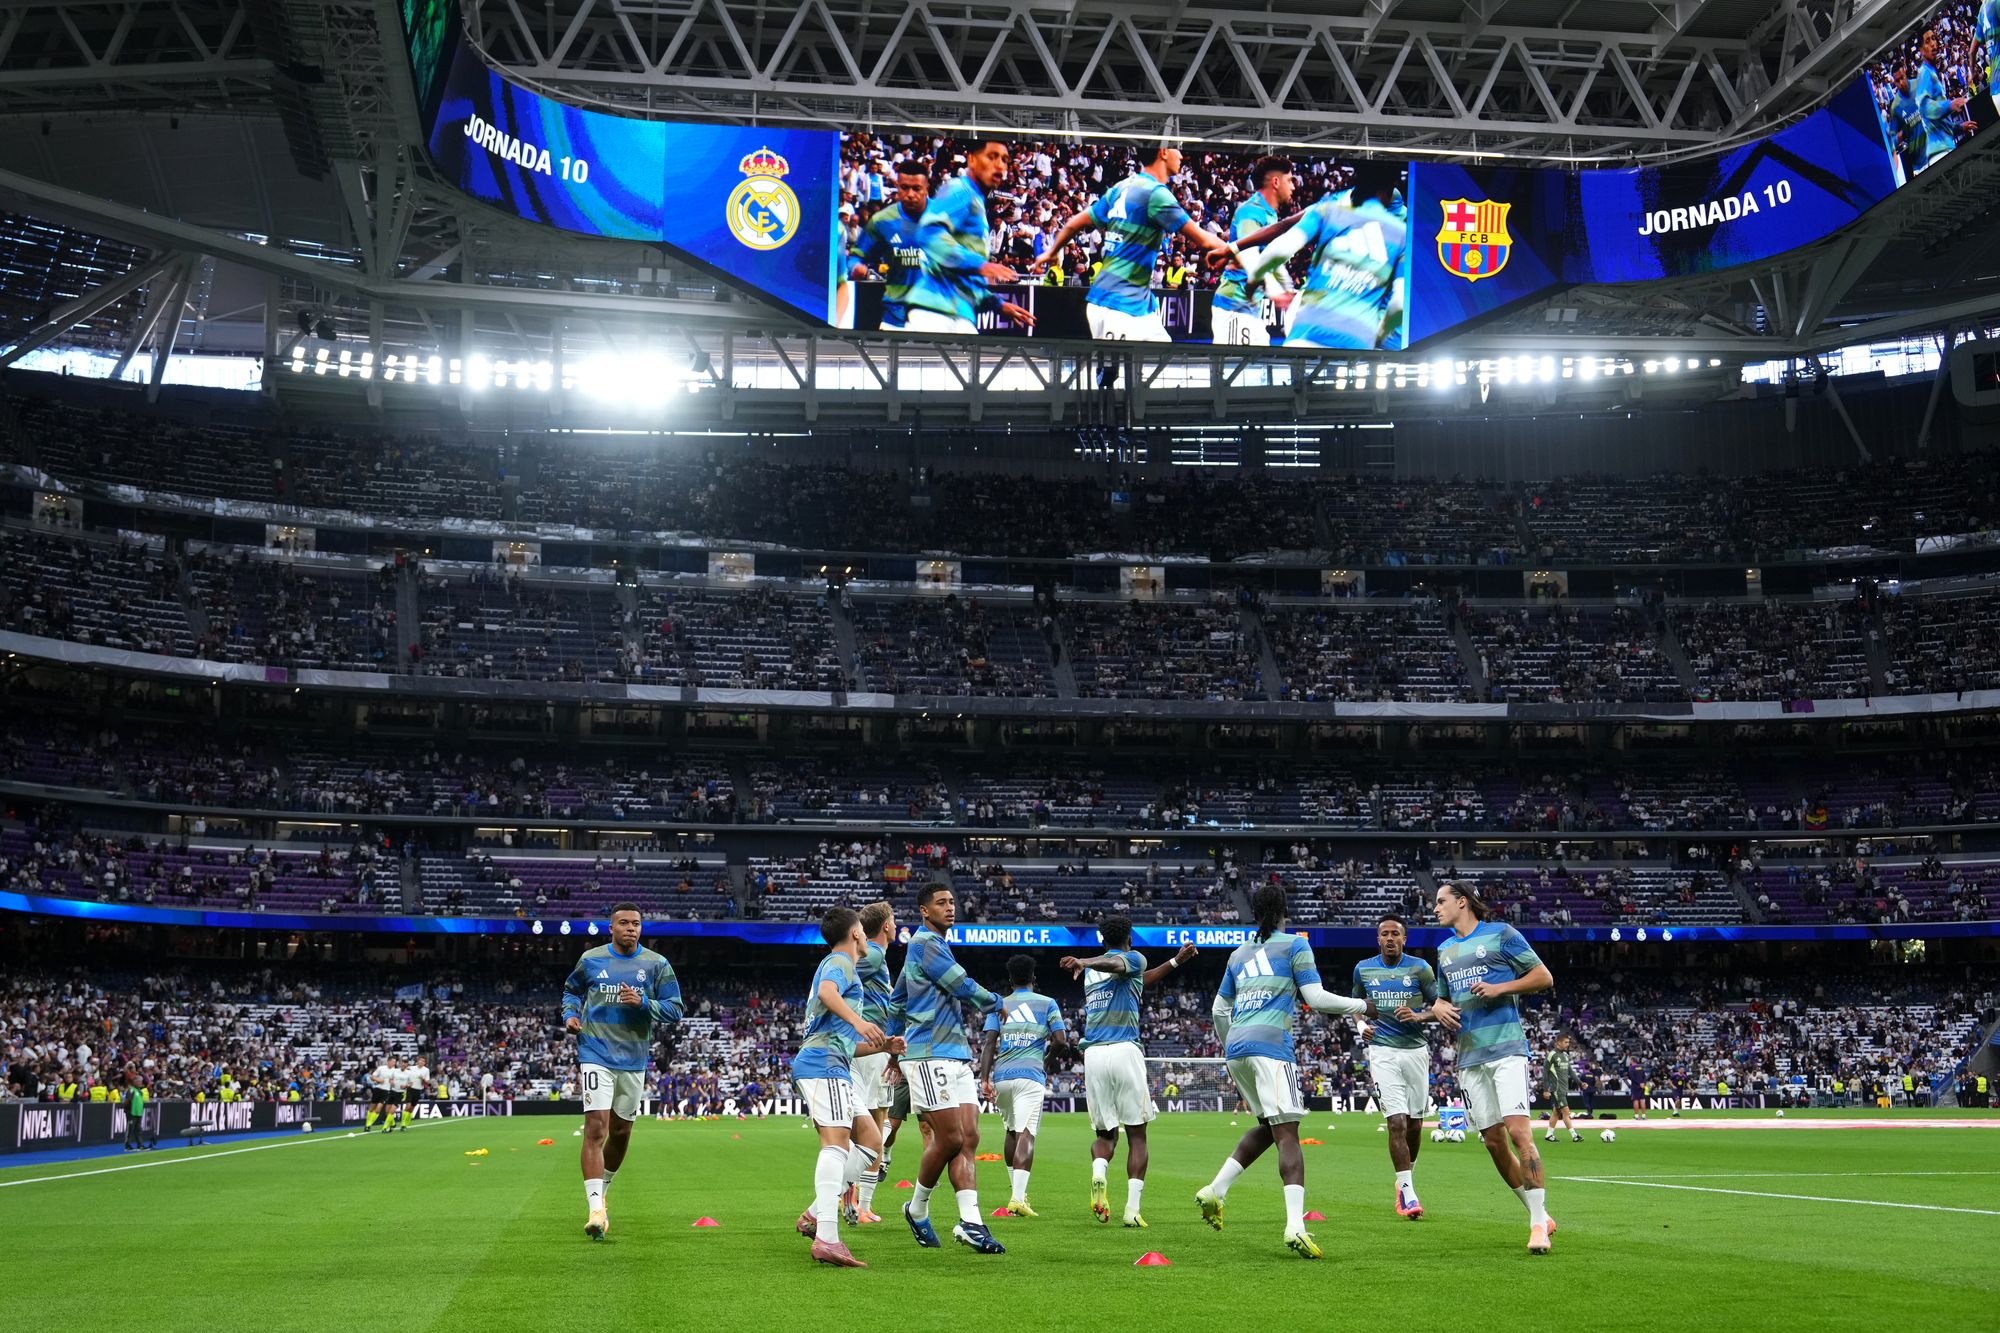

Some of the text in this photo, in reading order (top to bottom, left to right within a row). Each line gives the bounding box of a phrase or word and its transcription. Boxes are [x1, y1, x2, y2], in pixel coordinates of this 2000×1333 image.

[464, 113, 589, 184] JORNADA 10
[1638, 179, 1792, 236] JORNADA 10
[1241, 327, 1250, 345] 8
[970, 929, 1019, 943] MADRID
[1024, 929, 1038, 943] C.
[1041, 930, 1051, 943] F.
[1167, 930, 1178, 944] F.
[1446, 965, 1489, 983] Emirates
[1372, 989, 1413, 999] Emirates
[1003, 1032, 1038, 1042] Emirates
[583, 1071, 599, 1091] 10
[933, 1067, 948, 1087] 5
[451, 1103, 502, 1117] MEN
[1167, 1099, 1216, 1112] MEN
[1650, 1097, 1756, 1110] NIVEA MEN
[190, 1102, 218, 1132] BLACK
[226, 1101, 252, 1130] WHITE
[277, 1105, 294, 1123] NIVEA
[22, 1108, 79, 1140] NIVEA MEN
